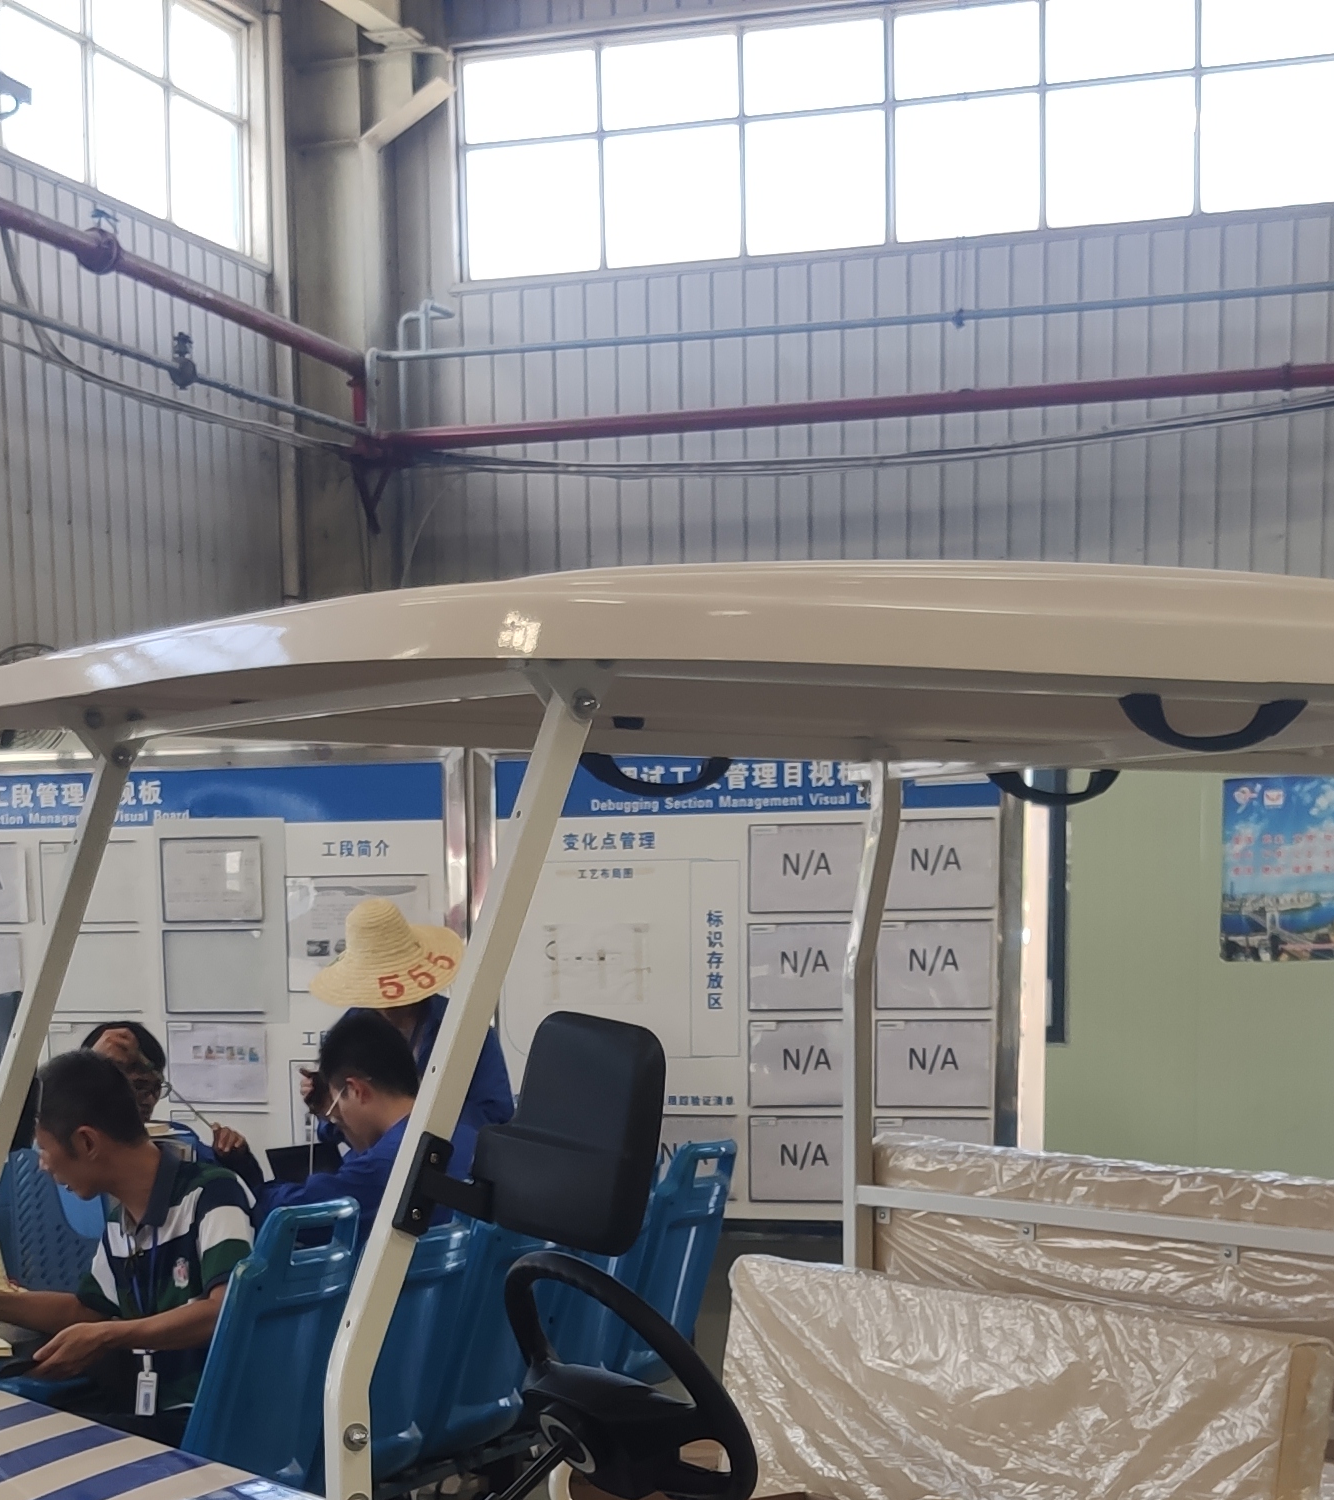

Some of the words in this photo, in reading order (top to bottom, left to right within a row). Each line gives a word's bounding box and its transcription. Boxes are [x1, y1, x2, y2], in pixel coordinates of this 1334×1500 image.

[591, 798, 659, 813] Debugging
[664, 796, 713, 810] Section
[719, 795, 804, 809] Management
[809, 793, 850, 806] Visual
[321, 839, 390, 858] 工段简介
[562, 831, 655, 851] 变化点管理
[577, 868, 633, 880] 工艺布局图
[781, 848, 832, 878] N/A
[910, 844, 962, 876] N/A
[706, 909, 724, 1010] 标识存放区
[779, 947, 830, 978] N/A
[908, 945, 959, 976] N/A
[377, 951, 455, 1000] 555
[782, 1044, 832, 1075] N/A
[908, 1043, 959, 1075] N/A
[779, 1140, 829, 1171] N/A
